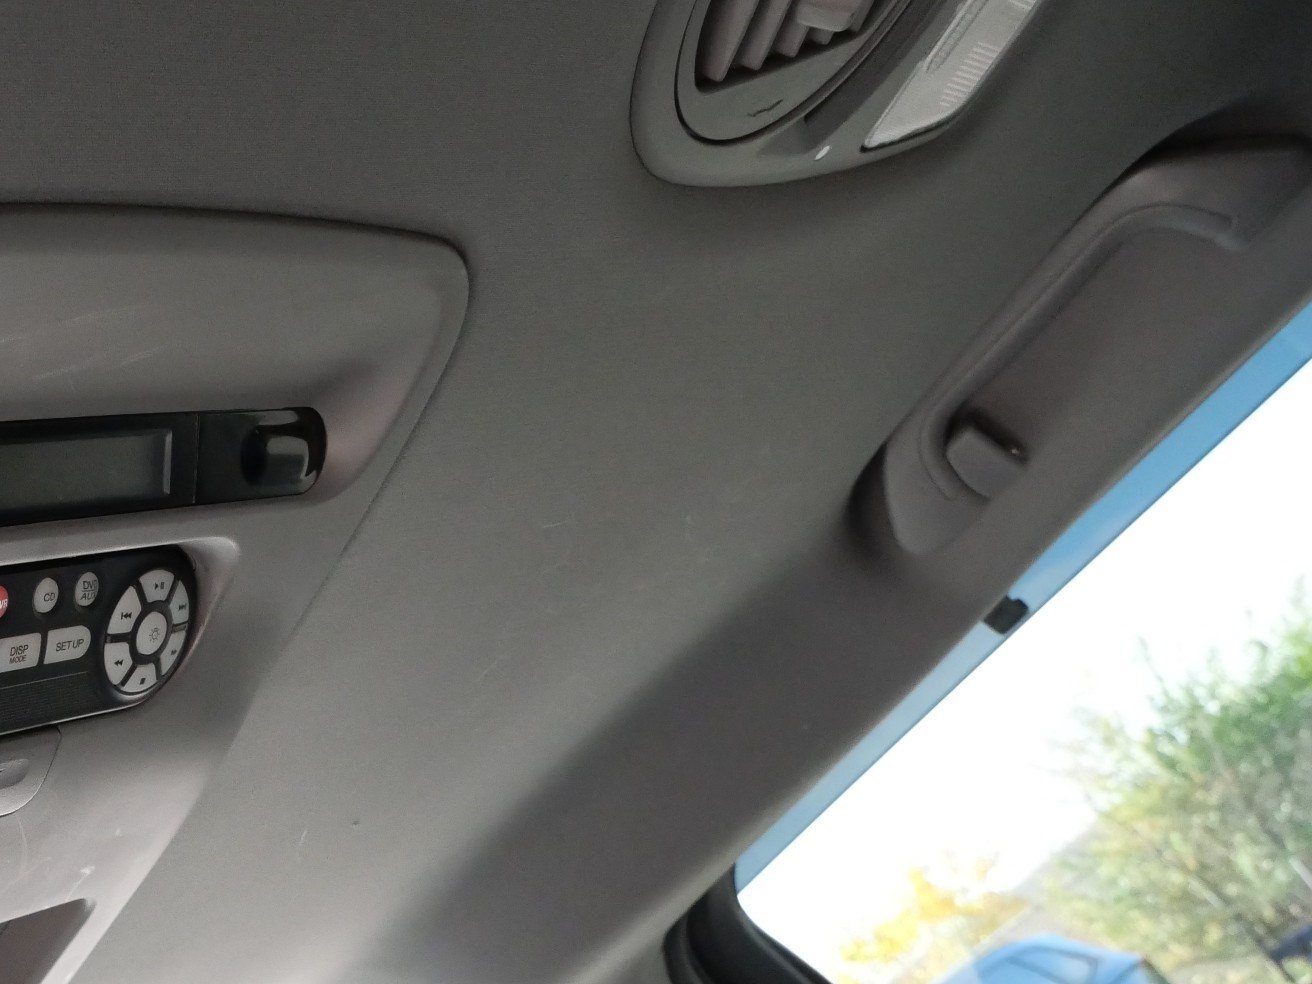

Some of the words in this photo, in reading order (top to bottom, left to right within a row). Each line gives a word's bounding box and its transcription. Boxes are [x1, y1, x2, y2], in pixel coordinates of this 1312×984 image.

[43, 593, 56, 602] CD
[10, 645, 29, 657] DISP
[9, 654, 27, 665] MODE
